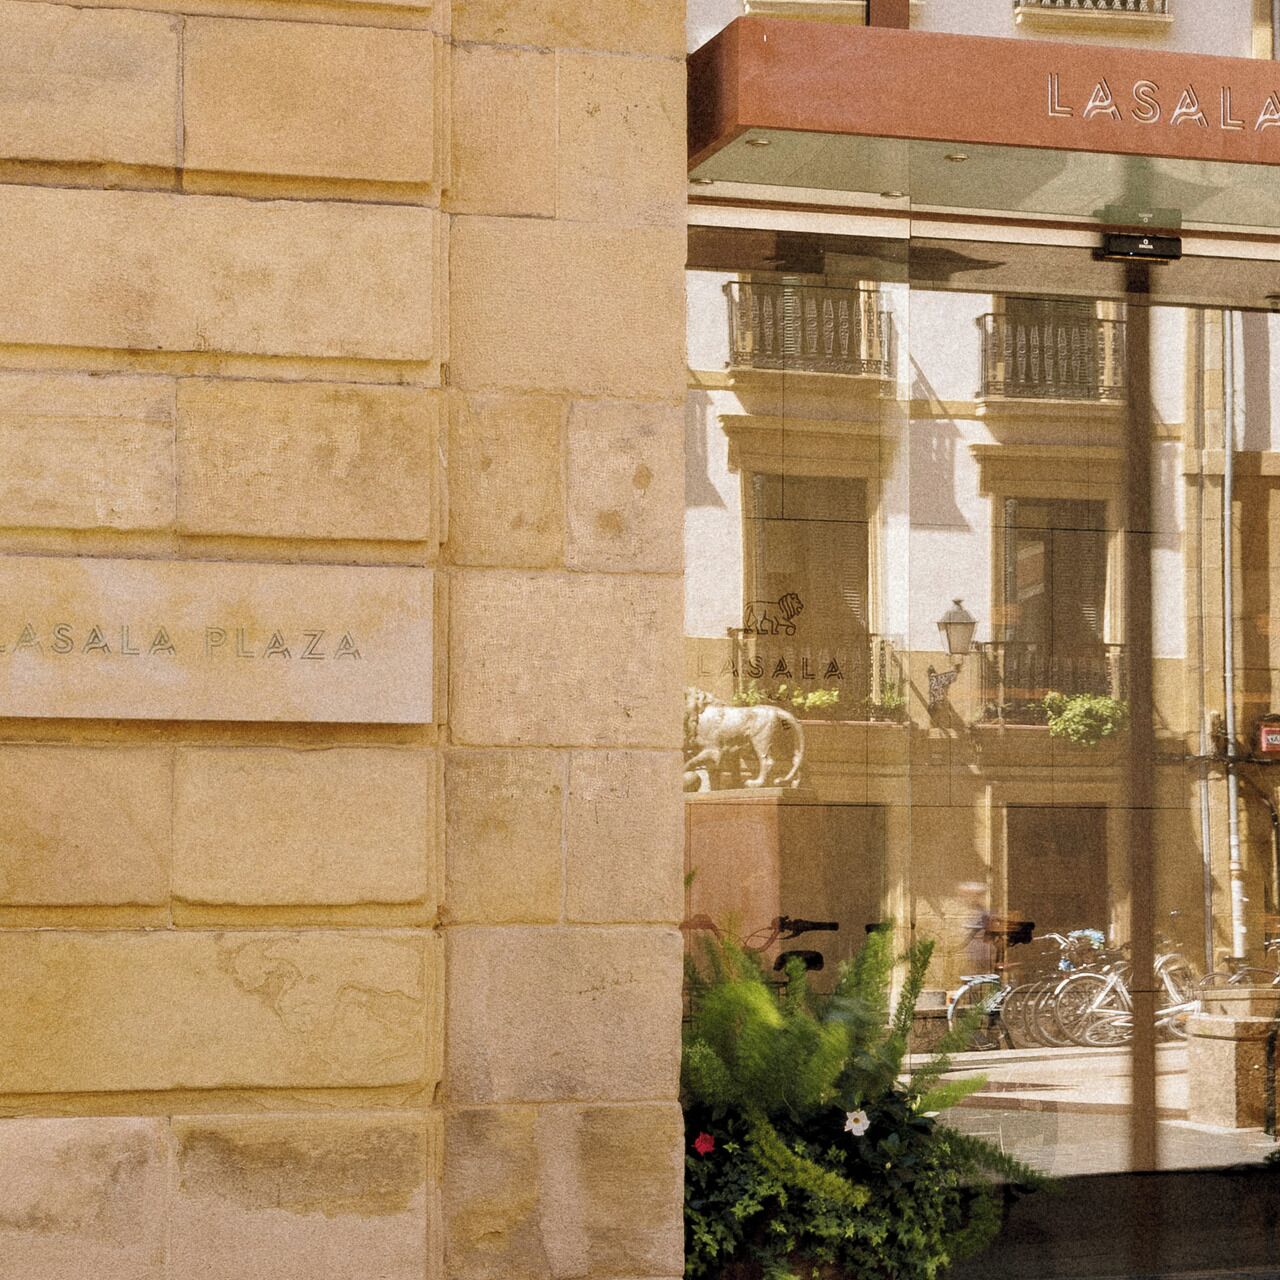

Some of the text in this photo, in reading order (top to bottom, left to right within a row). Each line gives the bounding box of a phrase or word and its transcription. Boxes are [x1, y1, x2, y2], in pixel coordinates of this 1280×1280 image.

[0, 622, 363, 661] ASALA PLAZA
[697, 654, 844, 680] LASALA
